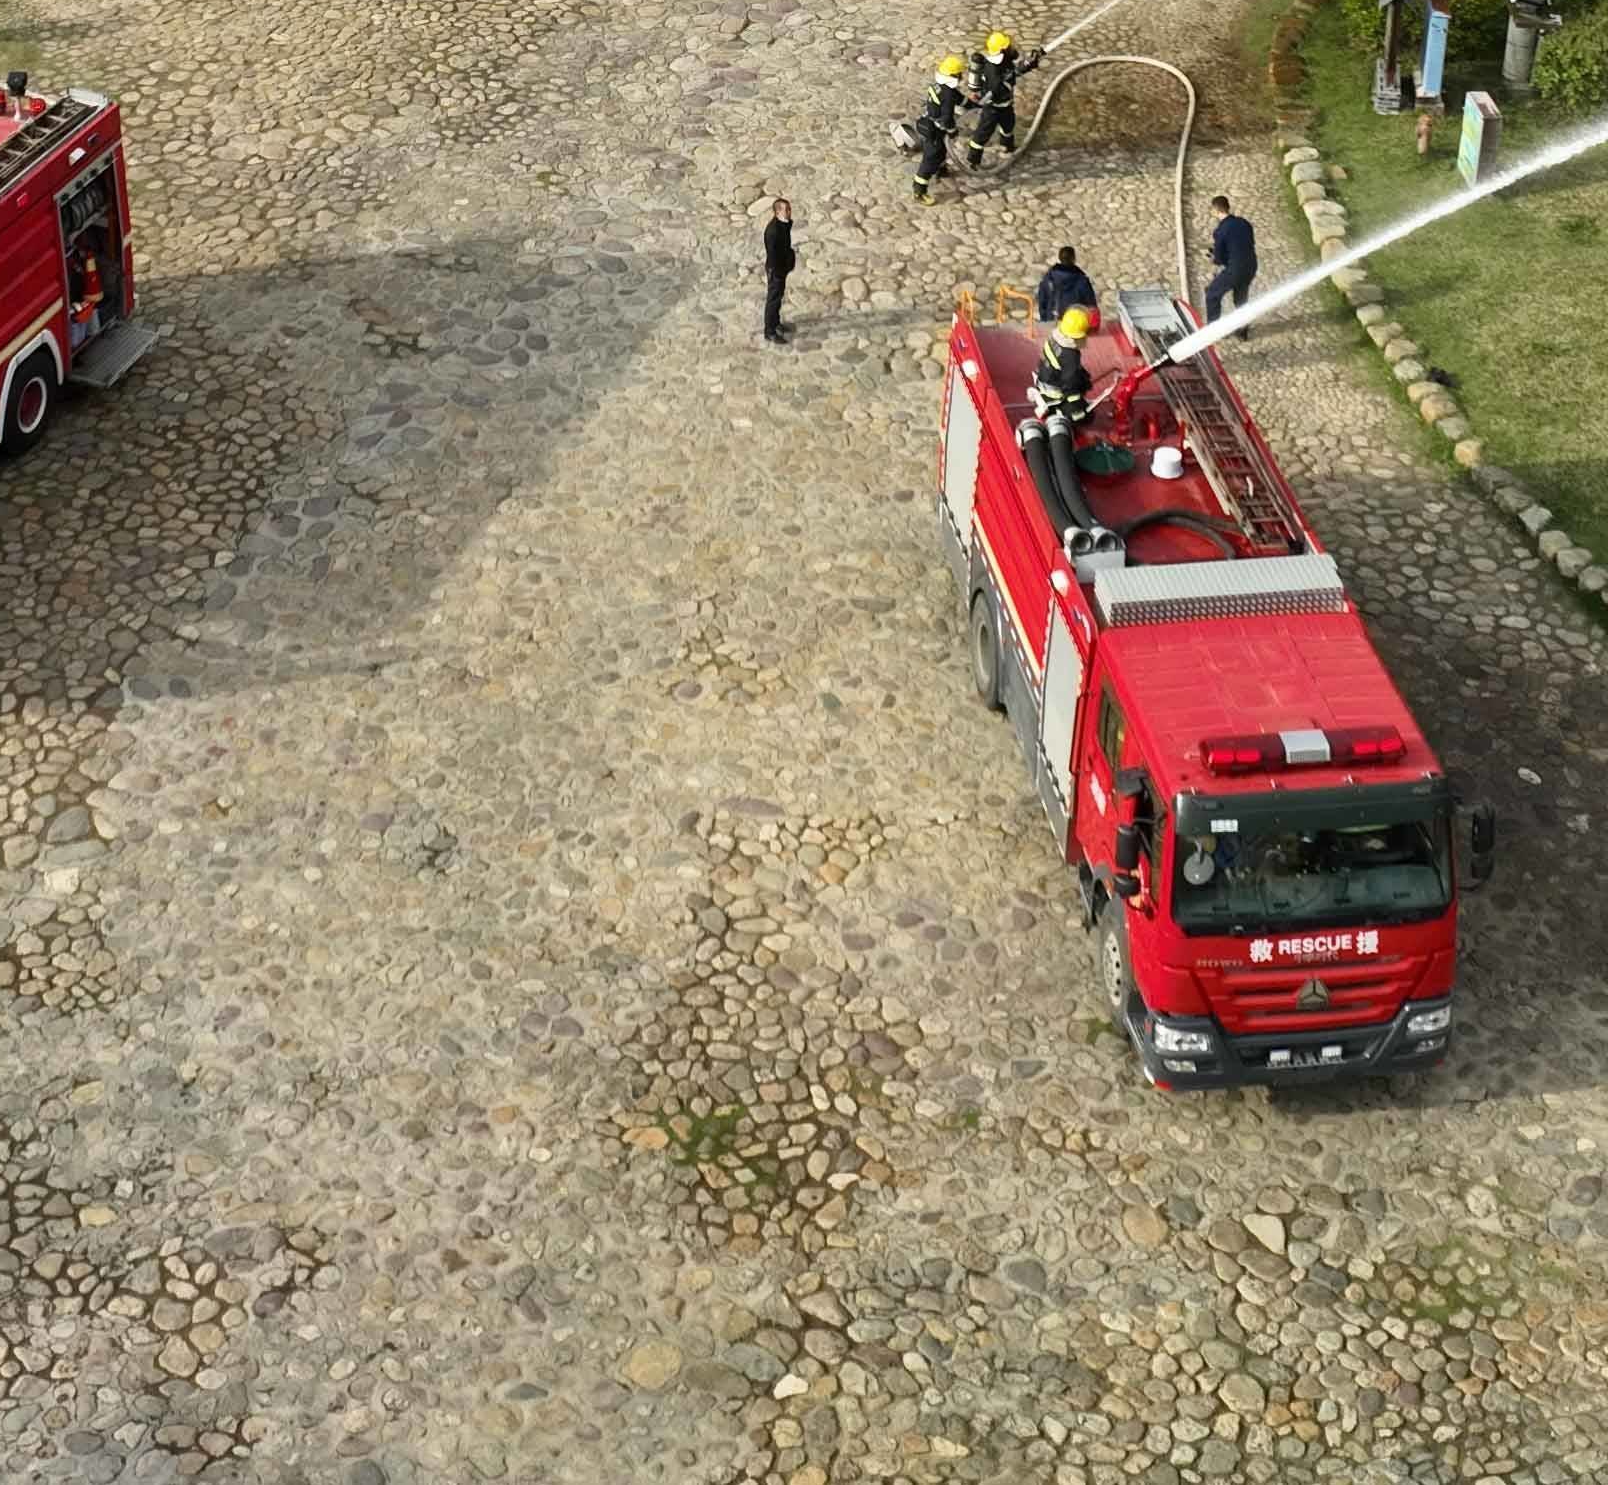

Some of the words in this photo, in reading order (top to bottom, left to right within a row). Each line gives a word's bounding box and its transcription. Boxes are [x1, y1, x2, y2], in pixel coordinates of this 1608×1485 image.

[1249, 938, 1274, 963] 救
[1278, 934, 1353, 956] RESCUE
[1355, 930, 1379, 955] 援
